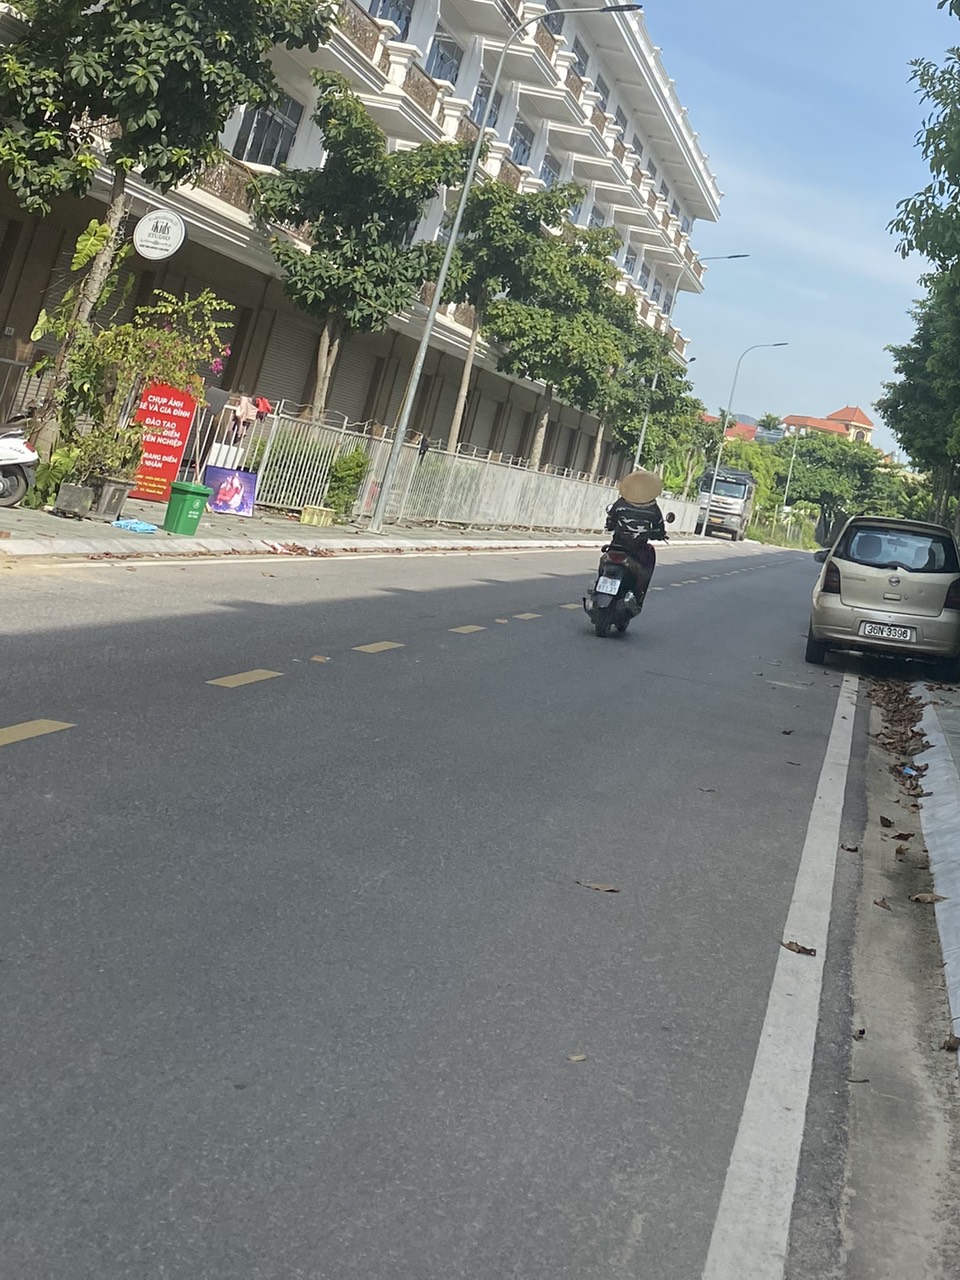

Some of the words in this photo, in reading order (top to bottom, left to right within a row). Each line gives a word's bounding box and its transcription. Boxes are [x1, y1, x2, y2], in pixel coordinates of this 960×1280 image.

[147, 394, 168, 406] CHỤP
[159, 406, 172, 415] GIA
[145, 416, 161, 426] ĐÀO
[143, 452, 162, 461] RANG
